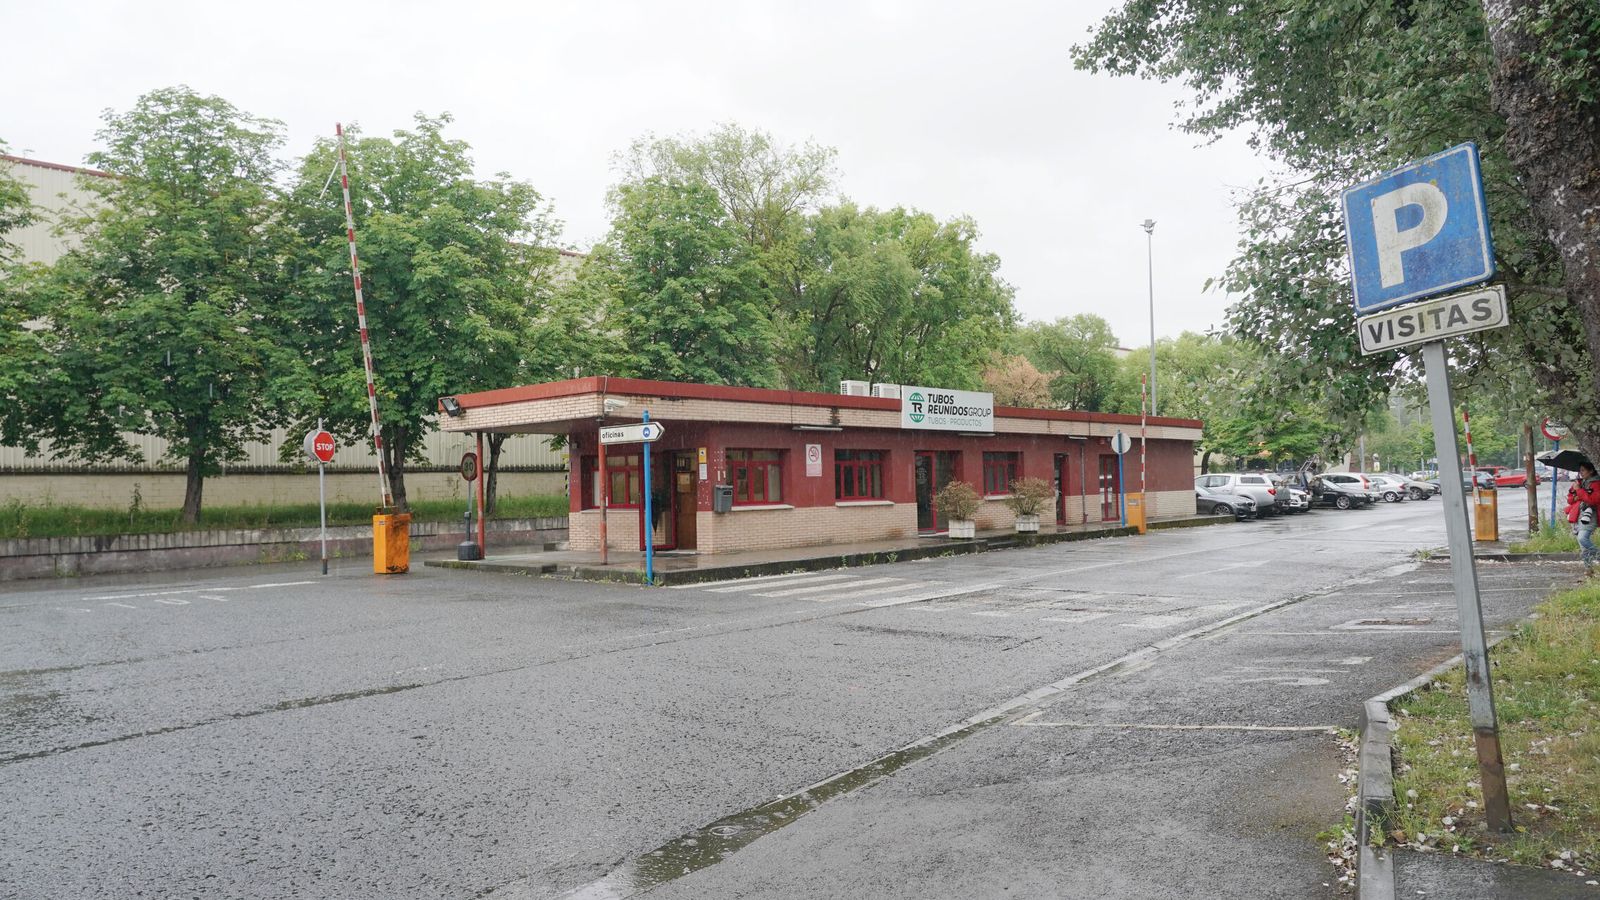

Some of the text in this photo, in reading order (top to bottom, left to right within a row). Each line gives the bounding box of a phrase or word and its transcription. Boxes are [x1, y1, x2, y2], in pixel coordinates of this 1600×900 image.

[1371, 182, 1448, 289] P
[1368, 298, 1492, 344] VISITAS
[928, 393, 954, 405] TUBOS
[928, 416, 982, 427] TUBOS PRODUCTOS
[602, 431, 624, 439] oficinas
[316, 443, 333, 451] STOP
